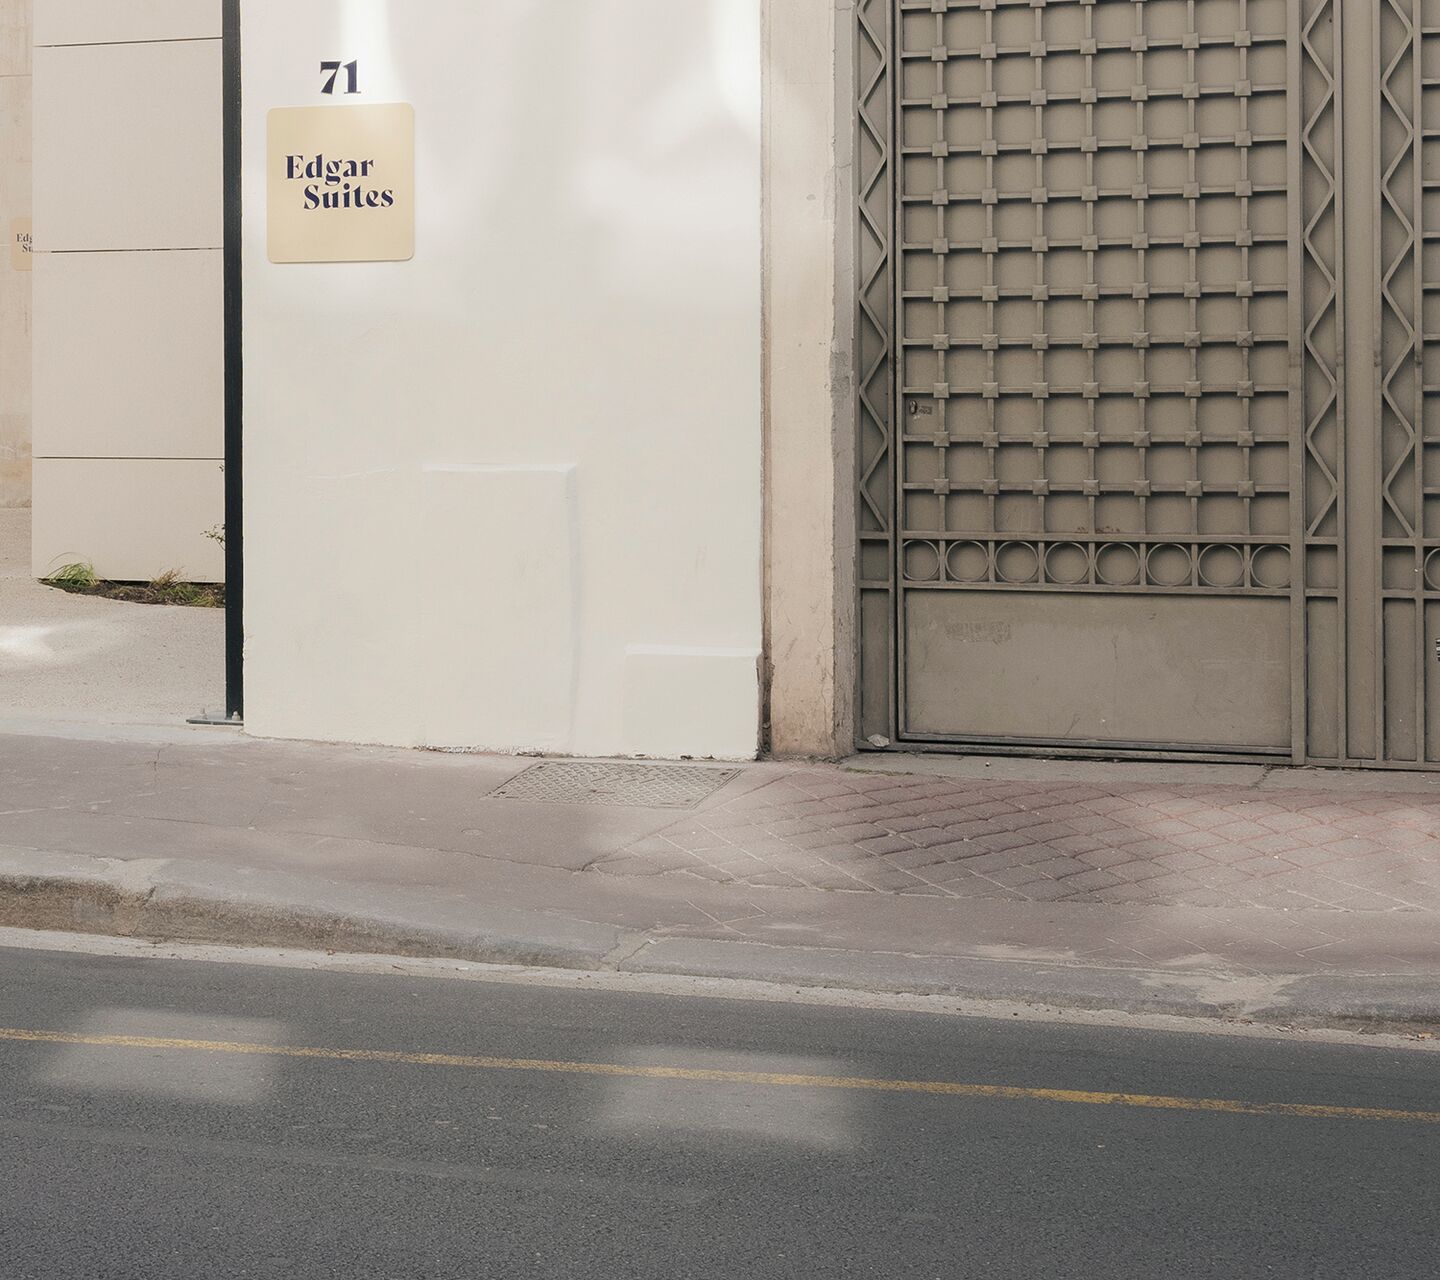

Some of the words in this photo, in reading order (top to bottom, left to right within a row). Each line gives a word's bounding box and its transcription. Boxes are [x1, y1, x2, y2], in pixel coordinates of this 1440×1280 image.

[320, 60, 361, 95] 71
[286, 154, 374, 187] Edgar
[304, 183, 394, 210] Suites
